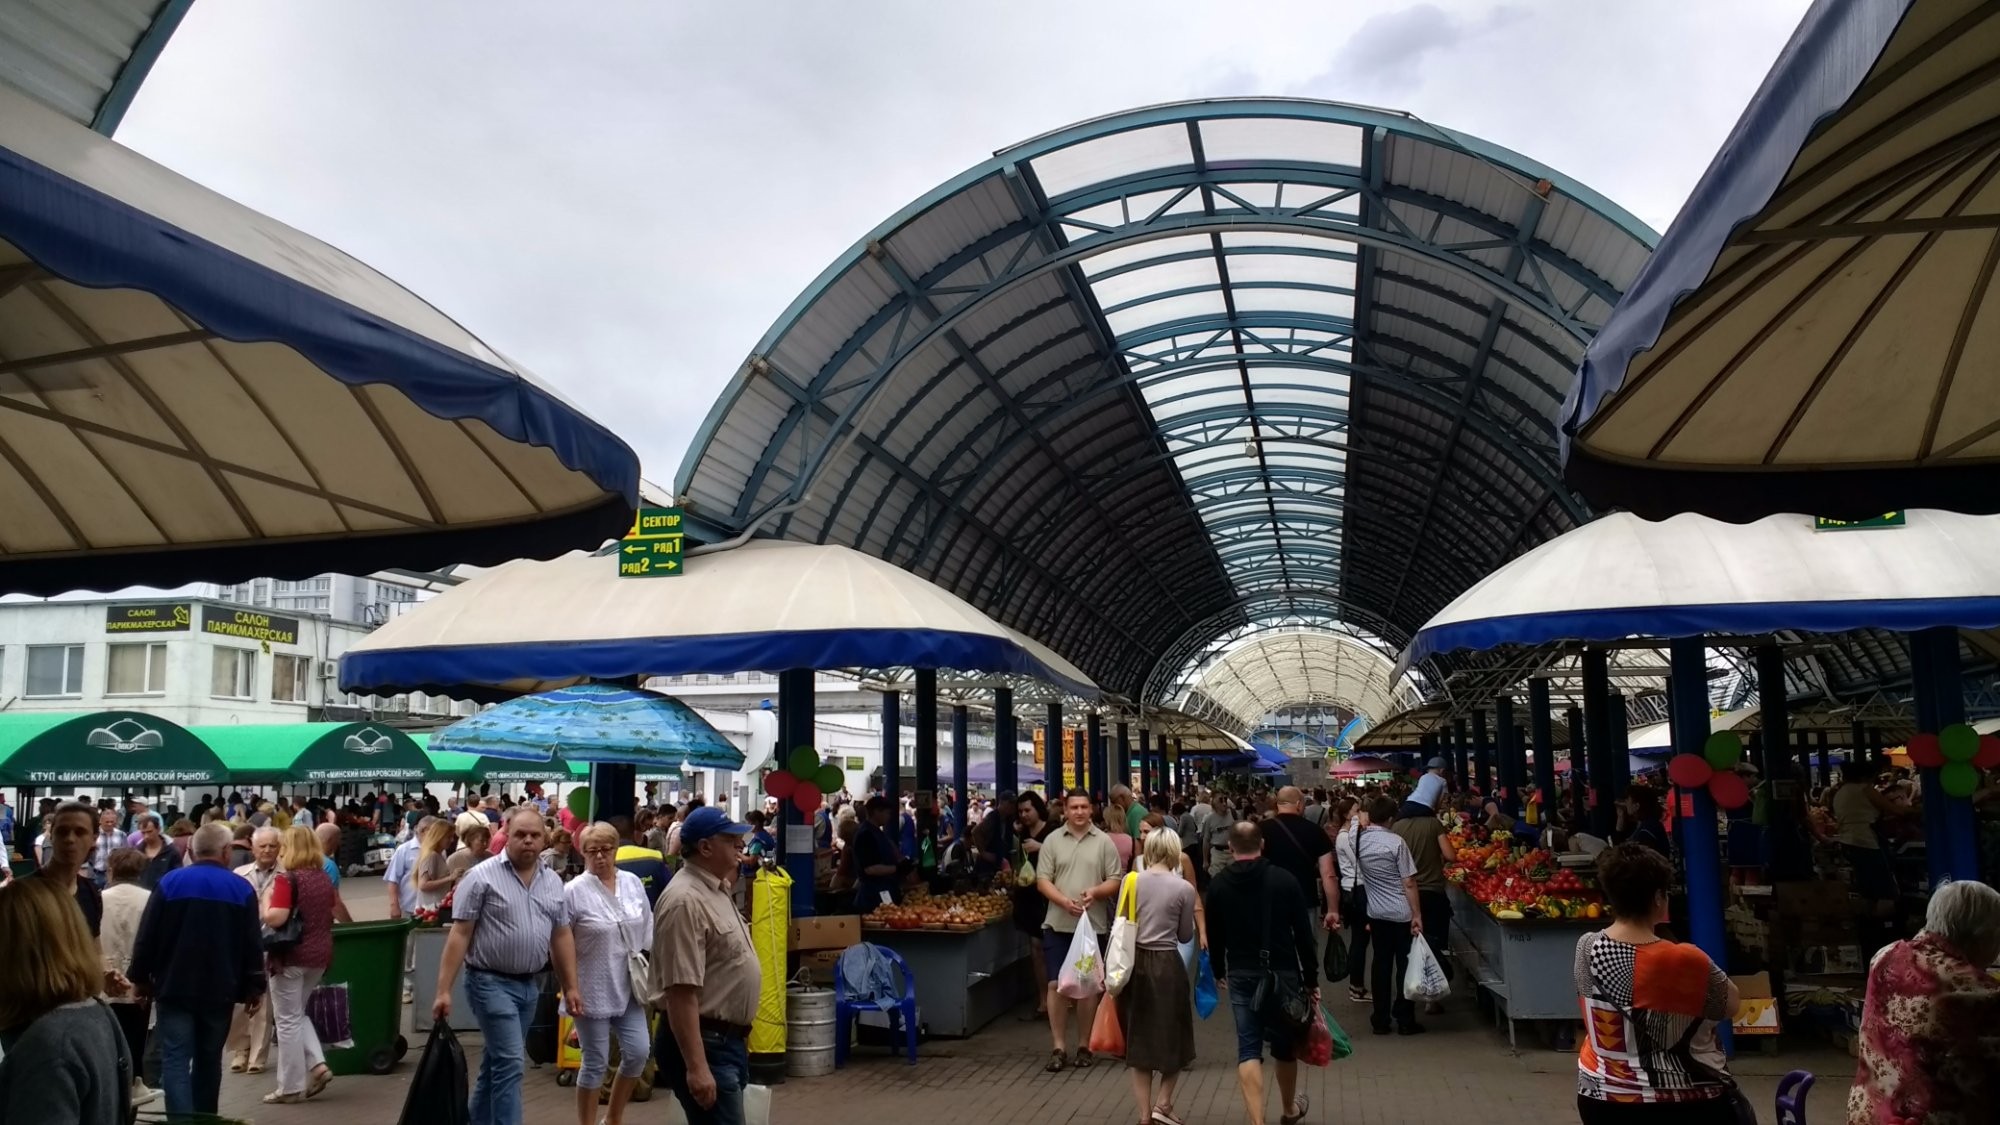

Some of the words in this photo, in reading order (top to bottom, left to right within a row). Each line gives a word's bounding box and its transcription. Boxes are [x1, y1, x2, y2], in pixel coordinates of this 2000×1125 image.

[642, 515, 680, 528] СЕКТОР
[127, 609, 156, 617] САЛОН
[106, 620, 177, 630] ПАРИКМАХЕРСКАЯ
[234, 612, 269, 627] САЛОН
[207, 620, 293, 642] ПАРИКМАХЕРСКАЯ
[30, 772, 55, 781] КТУП
[58, 770, 108, 781] «МИНСКИЙ
[111, 770, 175, 781] КОМАРОВСКИЙ
[177, 771, 210, 781] РЫНОК»
